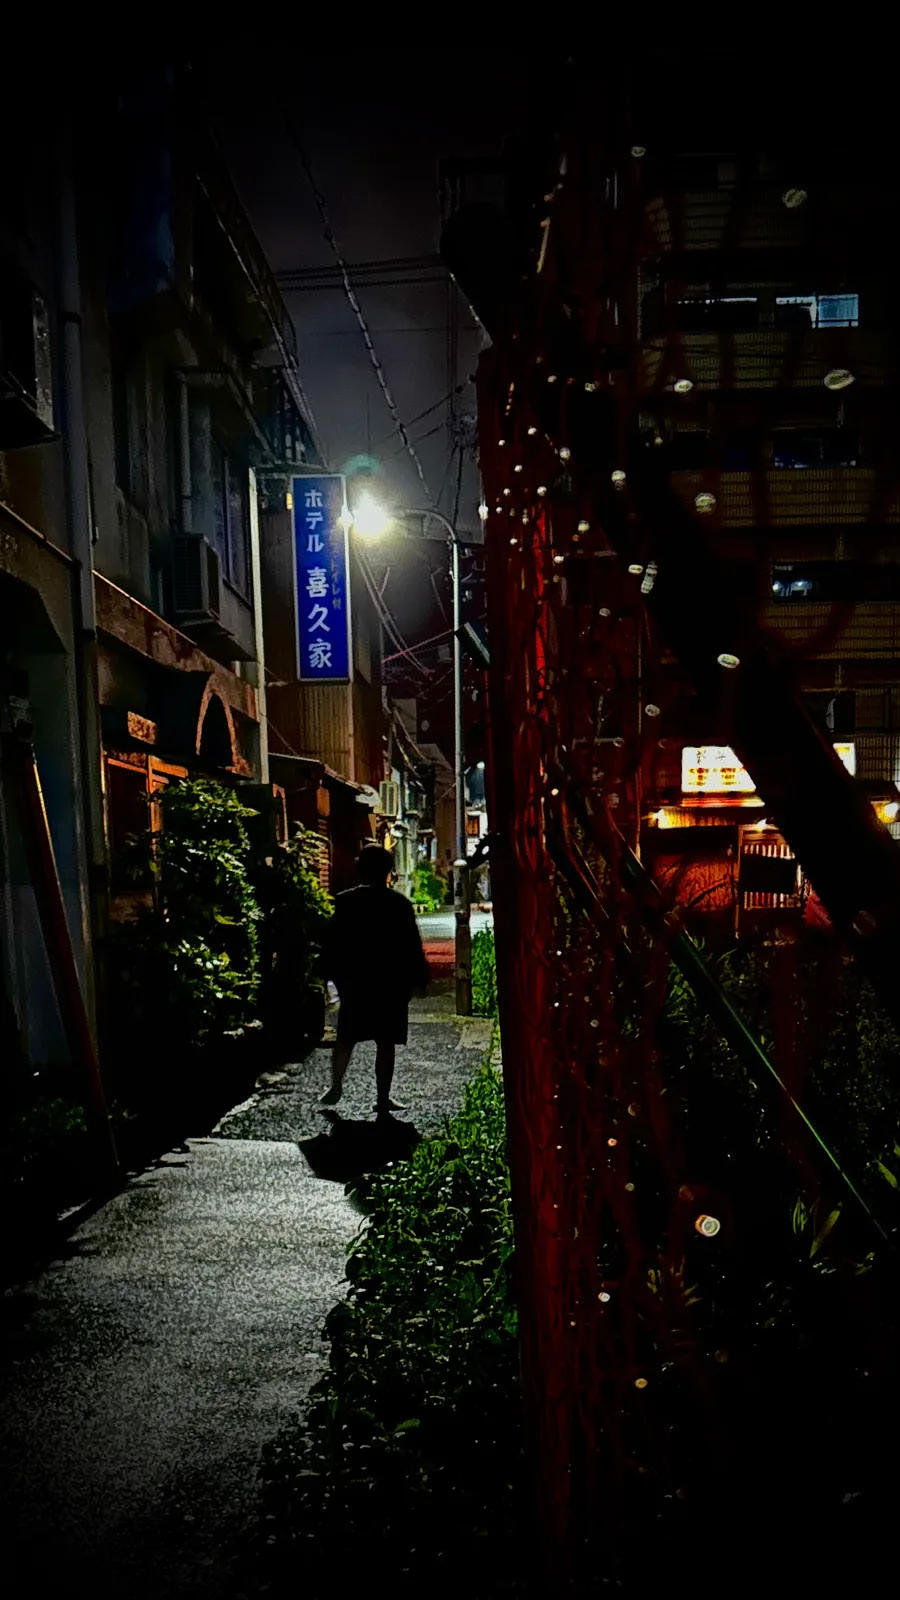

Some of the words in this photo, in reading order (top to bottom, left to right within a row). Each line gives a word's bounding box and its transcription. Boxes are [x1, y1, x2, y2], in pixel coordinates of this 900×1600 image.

[304, 489, 325, 553] ホテル
[306, 566, 333, 669] 喜久家
